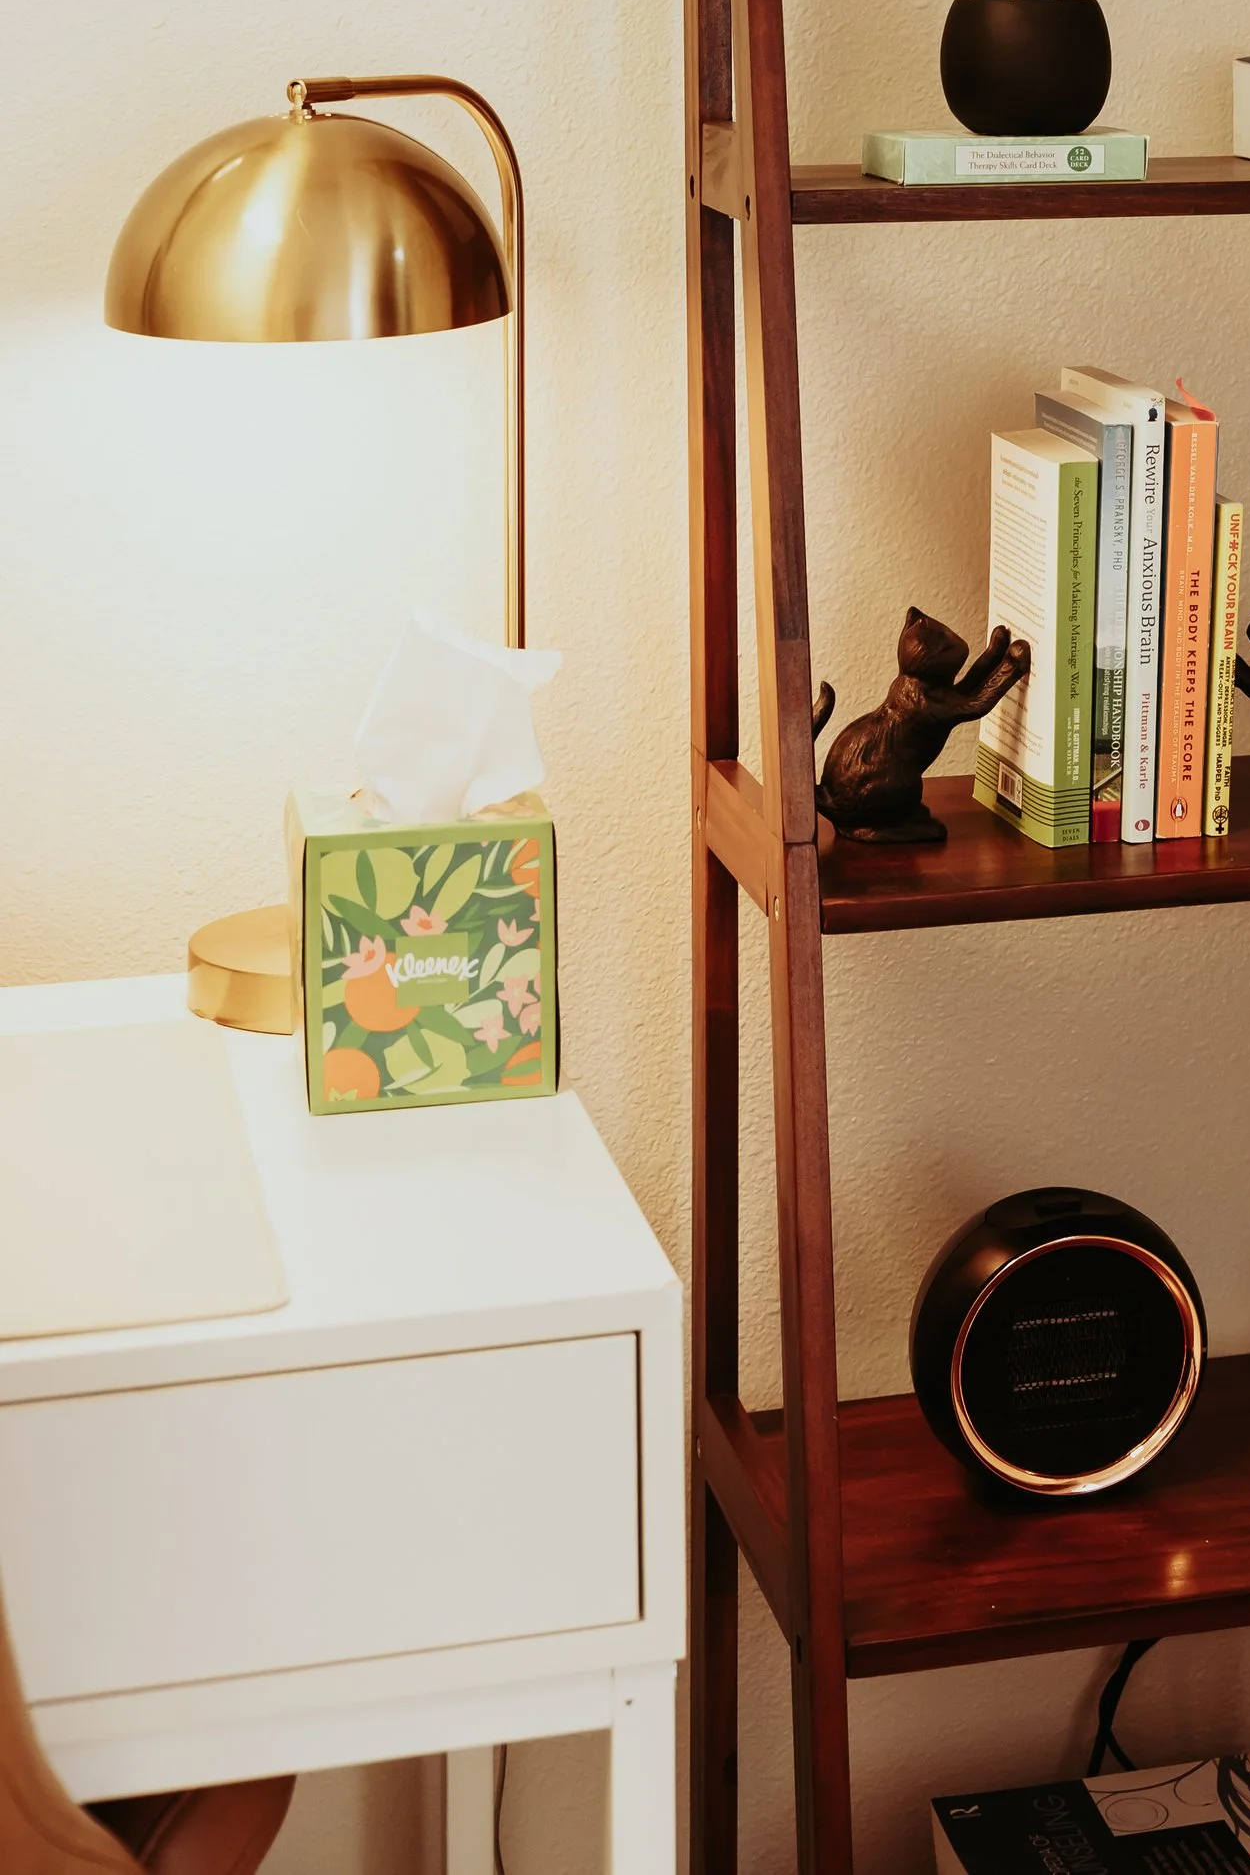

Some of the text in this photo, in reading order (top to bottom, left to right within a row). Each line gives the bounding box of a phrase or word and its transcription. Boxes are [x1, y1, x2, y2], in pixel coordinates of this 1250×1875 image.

[968, 161, 1058, 171] Therapy Skills Card Deck
[971, 151, 1055, 159] The Dialectical Behavior
[1190, 433, 1198, 464] BESSEL
[1073, 489, 1083, 518] Seven
[1112, 441, 1126, 570] GEORGE S. PRANSKY, PHD
[1070, 520, 1083, 568] Principles
[1139, 444, 1160, 665] Rewire Your Anxious Brain
[1071, 568, 1079, 580] for
[1225, 573, 1237, 609] YOUR
[1068, 581, 1082, 622] Making
[1067, 624, 1081, 669] Marriage
[1224, 613, 1235, 650] BRAIN
[1068, 672, 1080, 699] Work
[1182, 570, 1200, 782] THE BODY KEEPS THE SCORE
[1102, 697, 1110, 736] relationships
[1110, 699, 1123, 768] HANDBOOK
[1139, 692, 1150, 789] Pittman & Karle
[1172, 737, 1178, 747] OF
[1215, 753, 1223, 785] HARPER,
[385, 953, 480, 988] Kleenex
